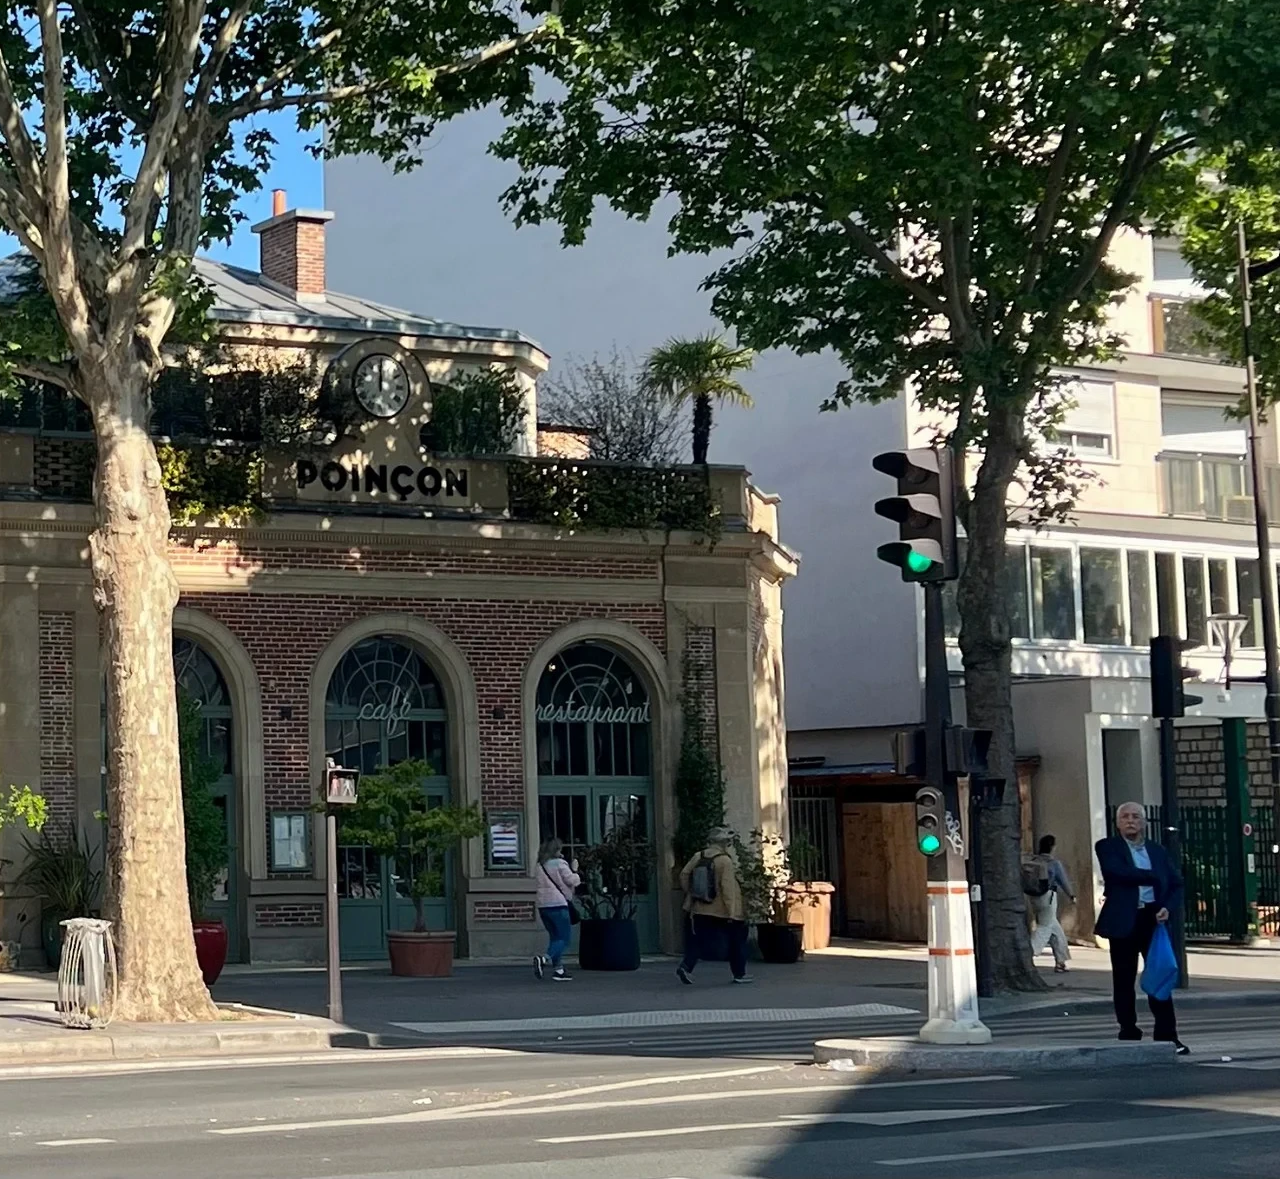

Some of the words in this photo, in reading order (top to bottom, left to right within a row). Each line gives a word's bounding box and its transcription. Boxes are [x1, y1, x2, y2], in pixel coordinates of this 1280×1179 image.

[296, 459, 468, 502] POINÇON
[356, 683, 412, 736] café
[535, 691, 652, 724] restaurant
